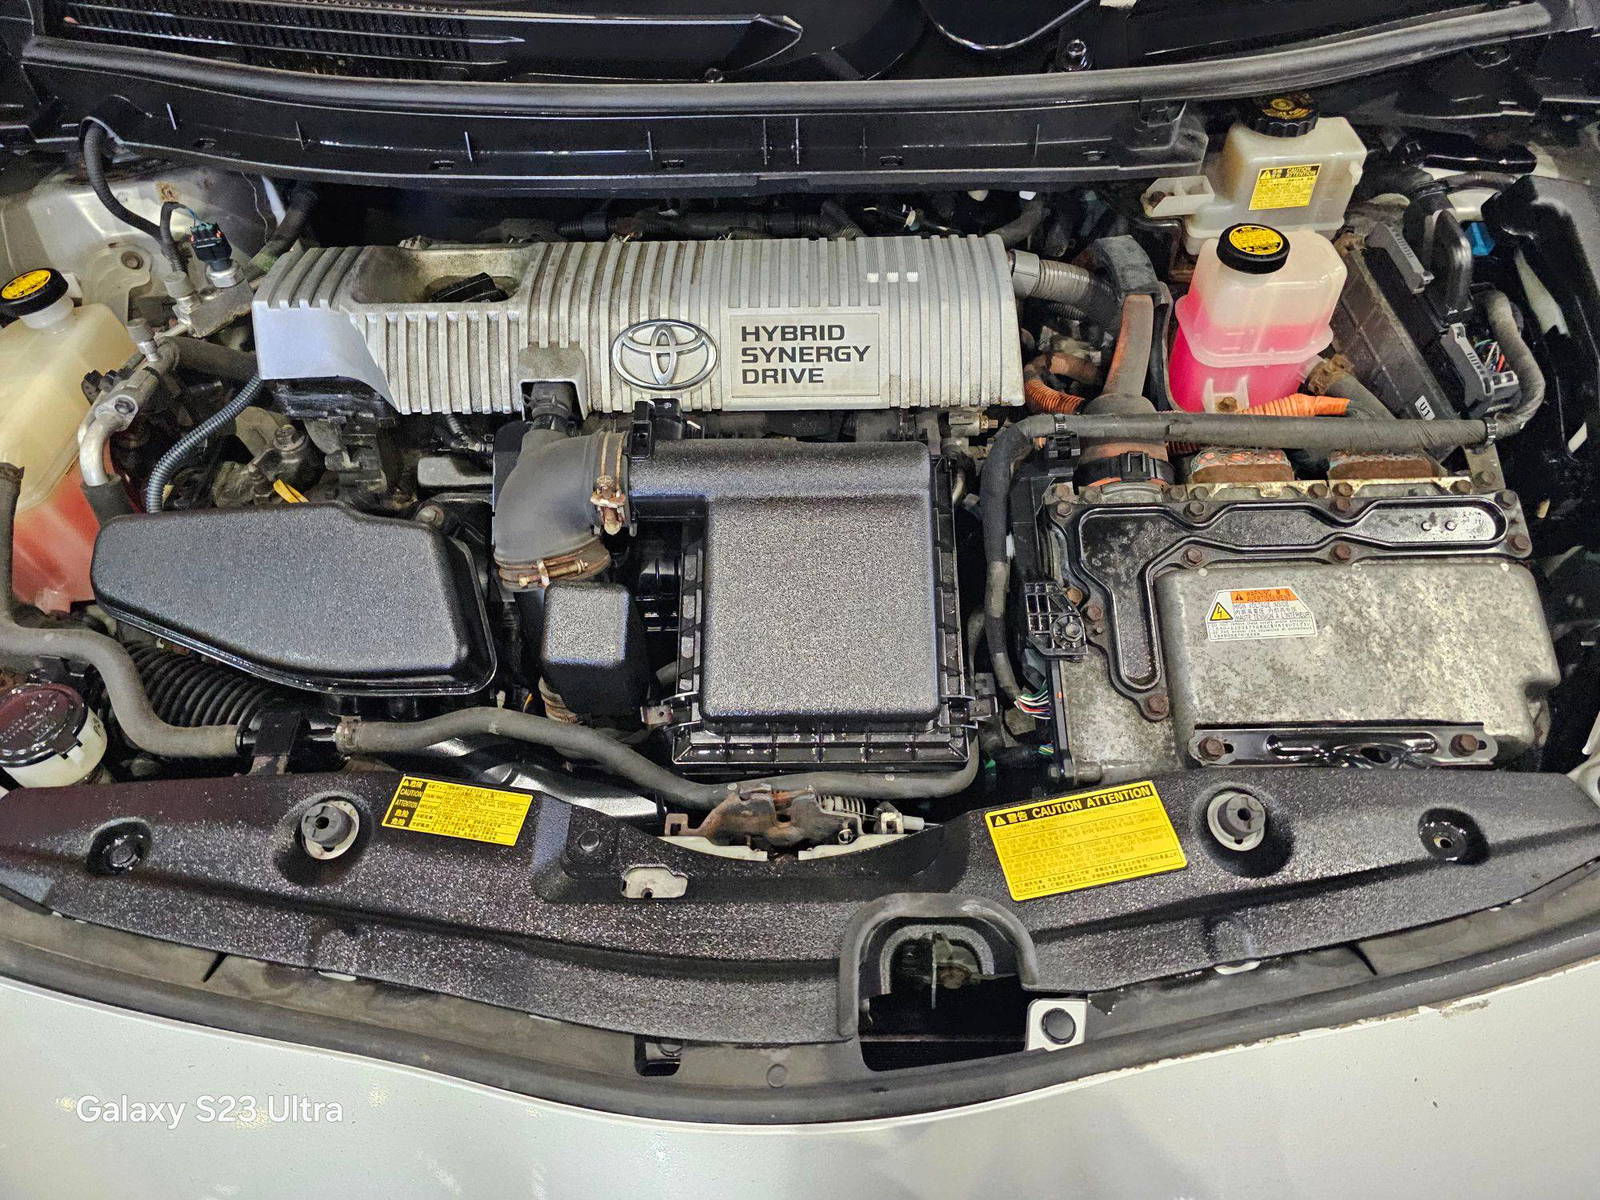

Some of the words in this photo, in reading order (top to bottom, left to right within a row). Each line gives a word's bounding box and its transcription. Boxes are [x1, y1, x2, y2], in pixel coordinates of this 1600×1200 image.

[741, 324, 845, 342] HYBRID
[741, 345, 871, 363] SYNERGY
[742, 368, 824, 384] DRIVE
[1420, 402, 1430, 417] U1
[400, 788, 423, 798] CAUTION
[1032, 799, 1083, 818] CAUTION
[1086, 784, 1151, 808] ATTENTION
